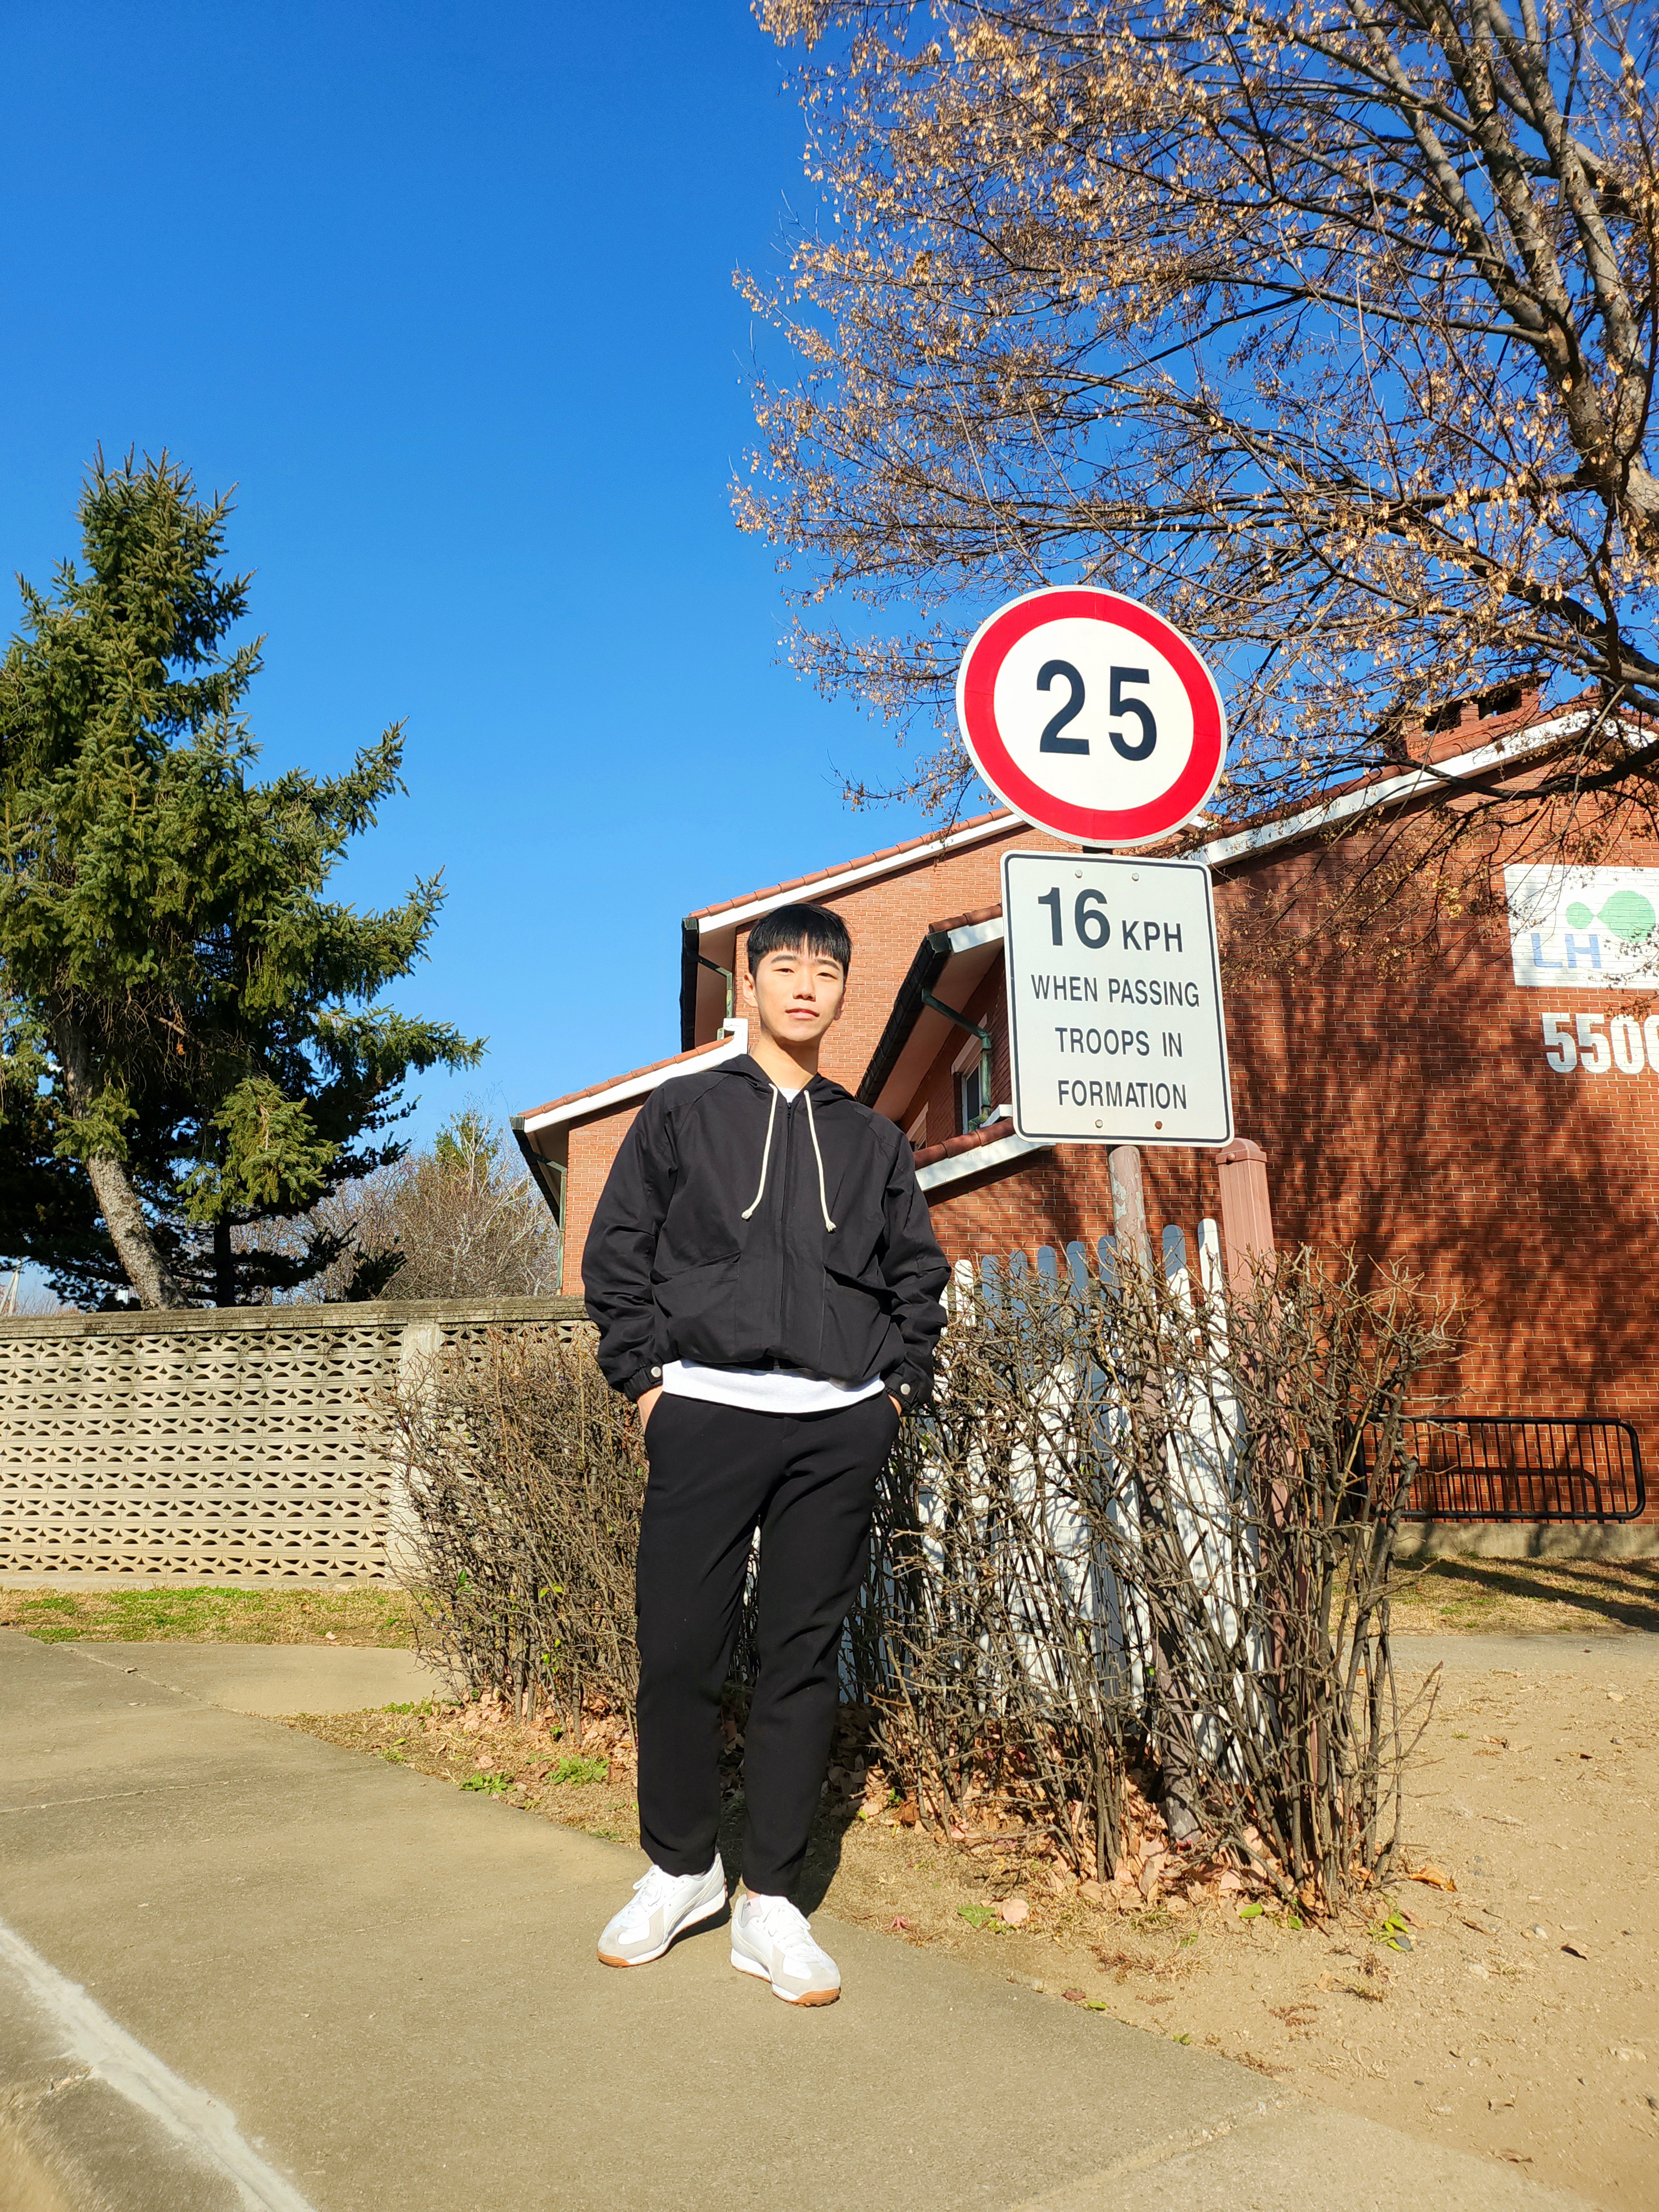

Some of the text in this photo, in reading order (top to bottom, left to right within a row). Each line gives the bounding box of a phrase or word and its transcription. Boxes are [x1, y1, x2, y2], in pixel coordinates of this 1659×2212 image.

[1036, 659, 1157, 761] 25
[1038, 887, 1183, 952] 16 KPH
[1531, 933, 1601, 968] LH
[1031, 974, 1199, 1008] WHEN PASSING
[1055, 1027, 1182, 1057] TROOPS IN
[1058, 1080, 1187, 1109] FORMATION
